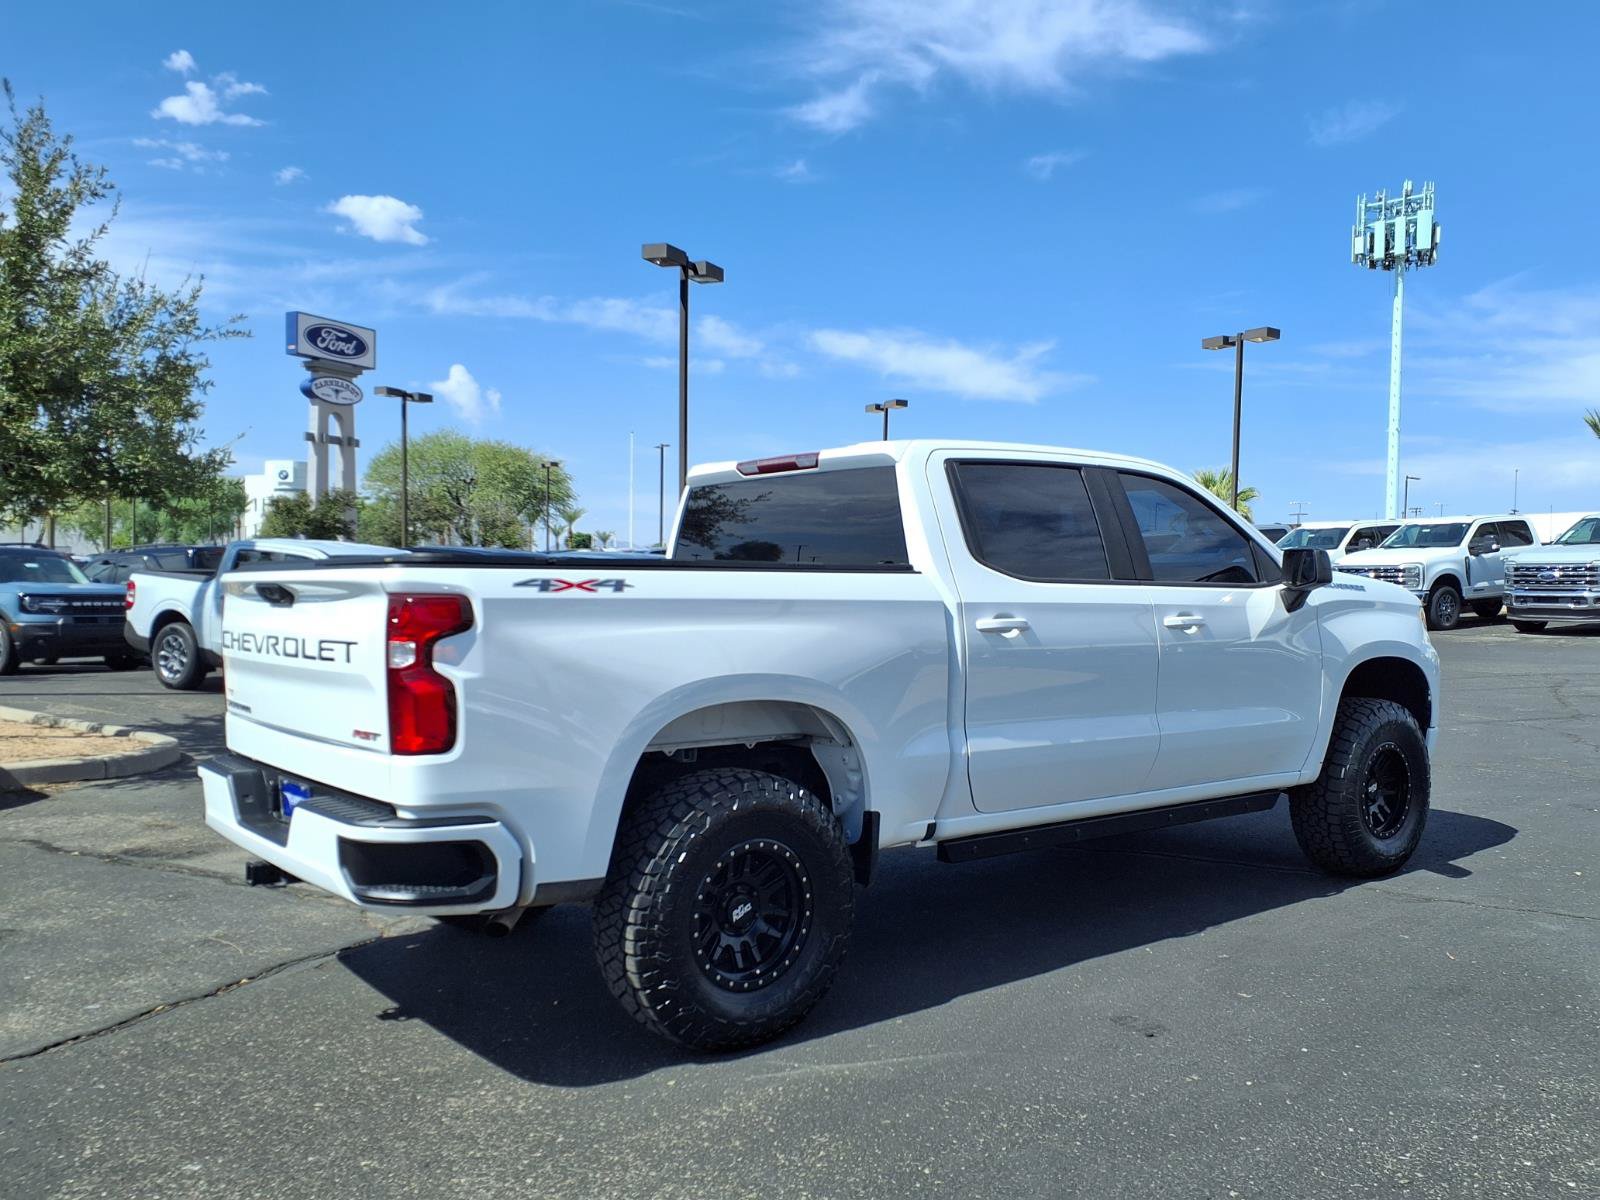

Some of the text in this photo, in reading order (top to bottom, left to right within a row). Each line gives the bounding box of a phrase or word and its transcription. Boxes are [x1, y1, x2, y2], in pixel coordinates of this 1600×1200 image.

[317, 328, 356, 354] Ford
[222, 630, 358, 664] CHEVROLET
[352, 729, 382, 742] RST
